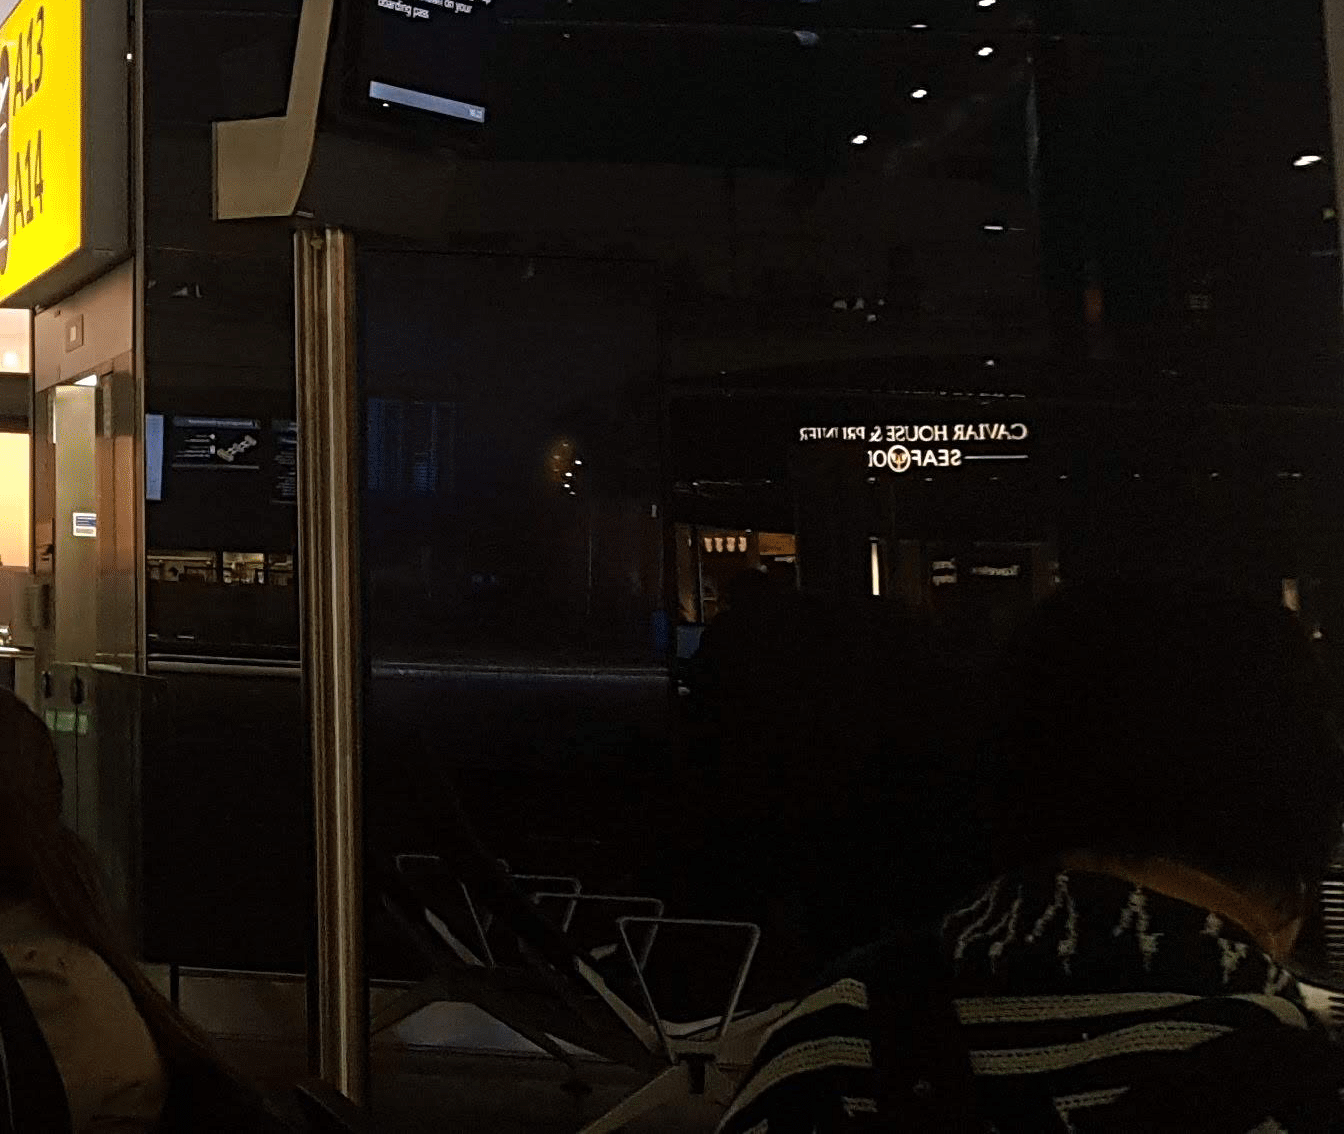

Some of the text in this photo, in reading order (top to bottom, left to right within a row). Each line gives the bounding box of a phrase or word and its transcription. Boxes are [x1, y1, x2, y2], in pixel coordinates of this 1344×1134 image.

[444, 0, 455, 9] on
[455, 2, 473, 14] your
[13, 5, 46, 116] A13
[13, 129, 44, 235] A14
